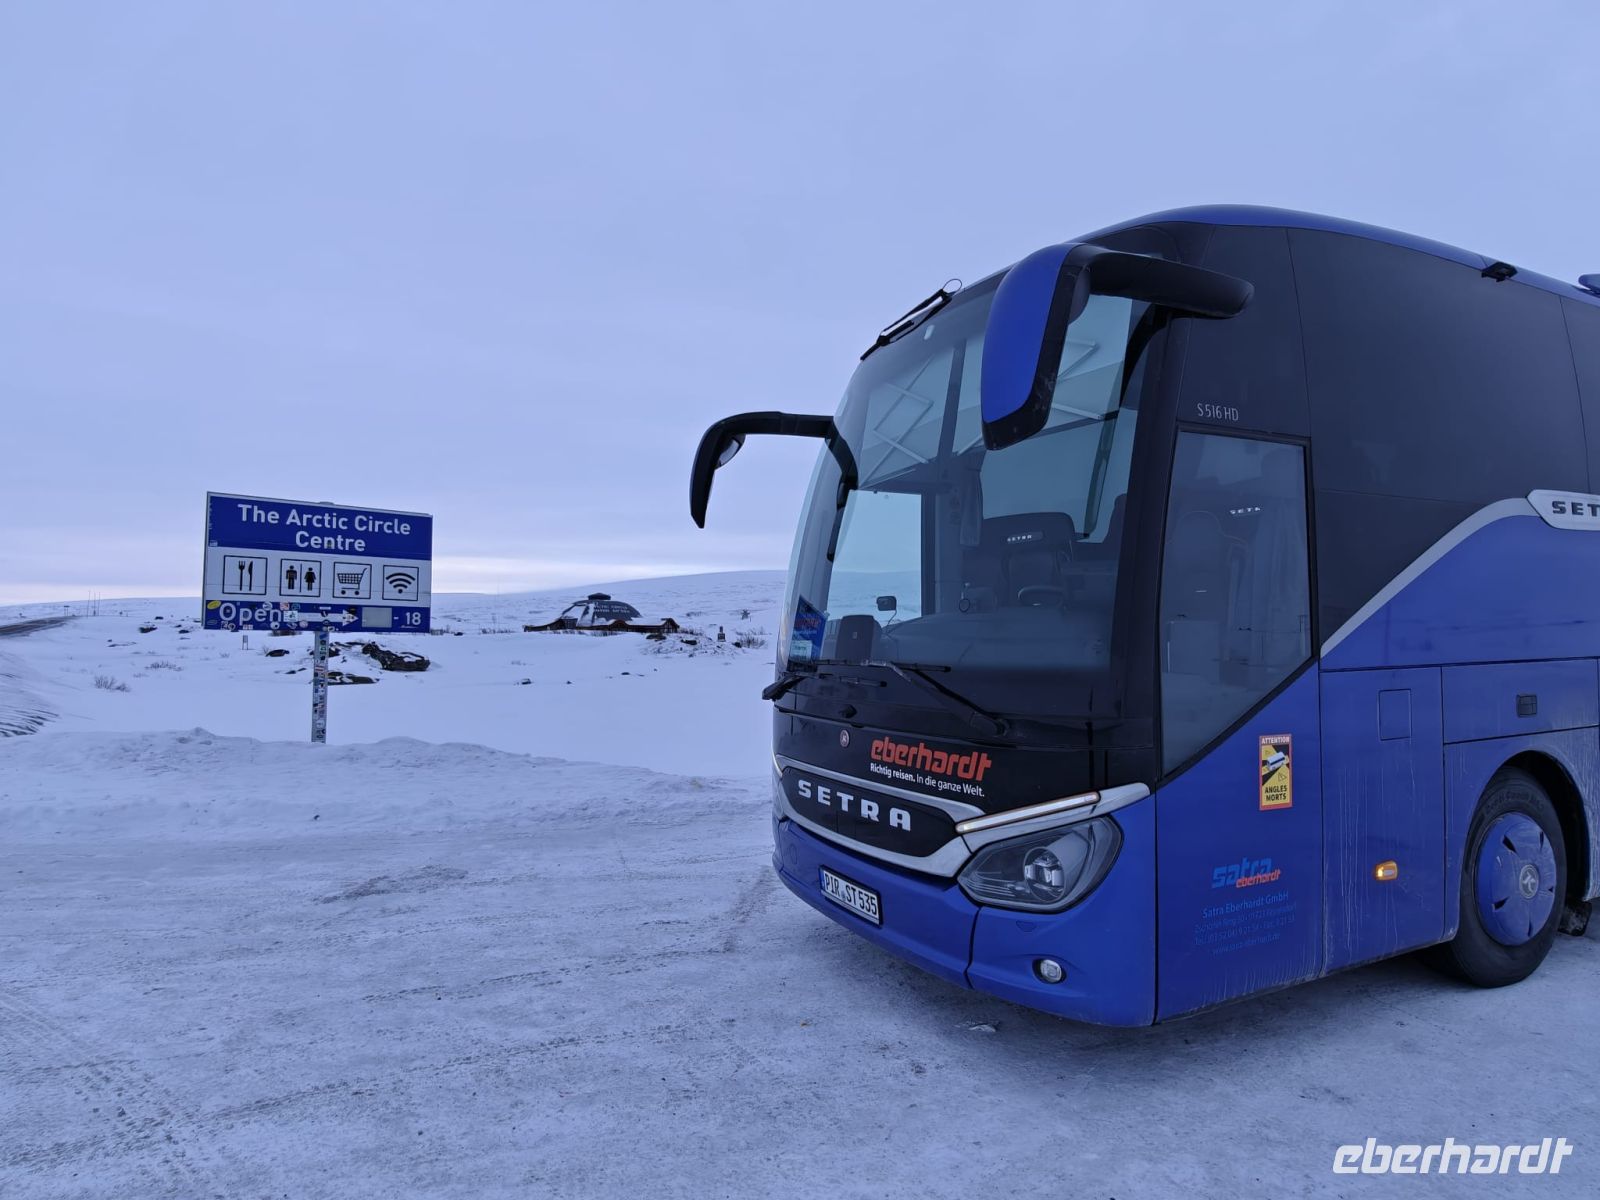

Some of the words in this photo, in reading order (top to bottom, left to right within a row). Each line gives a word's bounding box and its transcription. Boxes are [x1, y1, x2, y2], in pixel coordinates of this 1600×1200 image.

[1197, 402, 1204, 417] S
[1205, 404, 1222, 419] 516
[1223, 406, 1239, 421] HD
[237, 504, 280, 524] The
[286, 508, 349, 530] Arctic
[354, 515, 411, 535] Circle
[295, 531, 366, 552] Centre
[219, 602, 282, 626] Open
[405, 611, 421, 626] 18
[1261, 736, 1290, 745] ATTENTION
[870, 736, 992, 782] eberhardt
[870, 762, 892, 779] Richtig
[892, 769, 916, 783] reisen.
[916, 773, 924, 785] In
[925, 775, 937, 788] die
[938, 781, 962, 793] ganze
[962, 783, 985, 798] Welt.
[1264, 785, 1287, 794] ANGLES
[798, 778, 912, 832] SETRA
[1265, 793, 1287, 802] MORTS
[1211, 857, 1272, 889] satra
[1236, 869, 1281, 888] eberhardt
[824, 873, 841, 898] PIR
[845, 884, 857, 906] ST
[858, 890, 877, 916] 535
[1202, 906, 1224, 919] Satra
[1225, 897, 1265, 914] Eberhardt
[1265, 891, 1289, 904] GmbH
